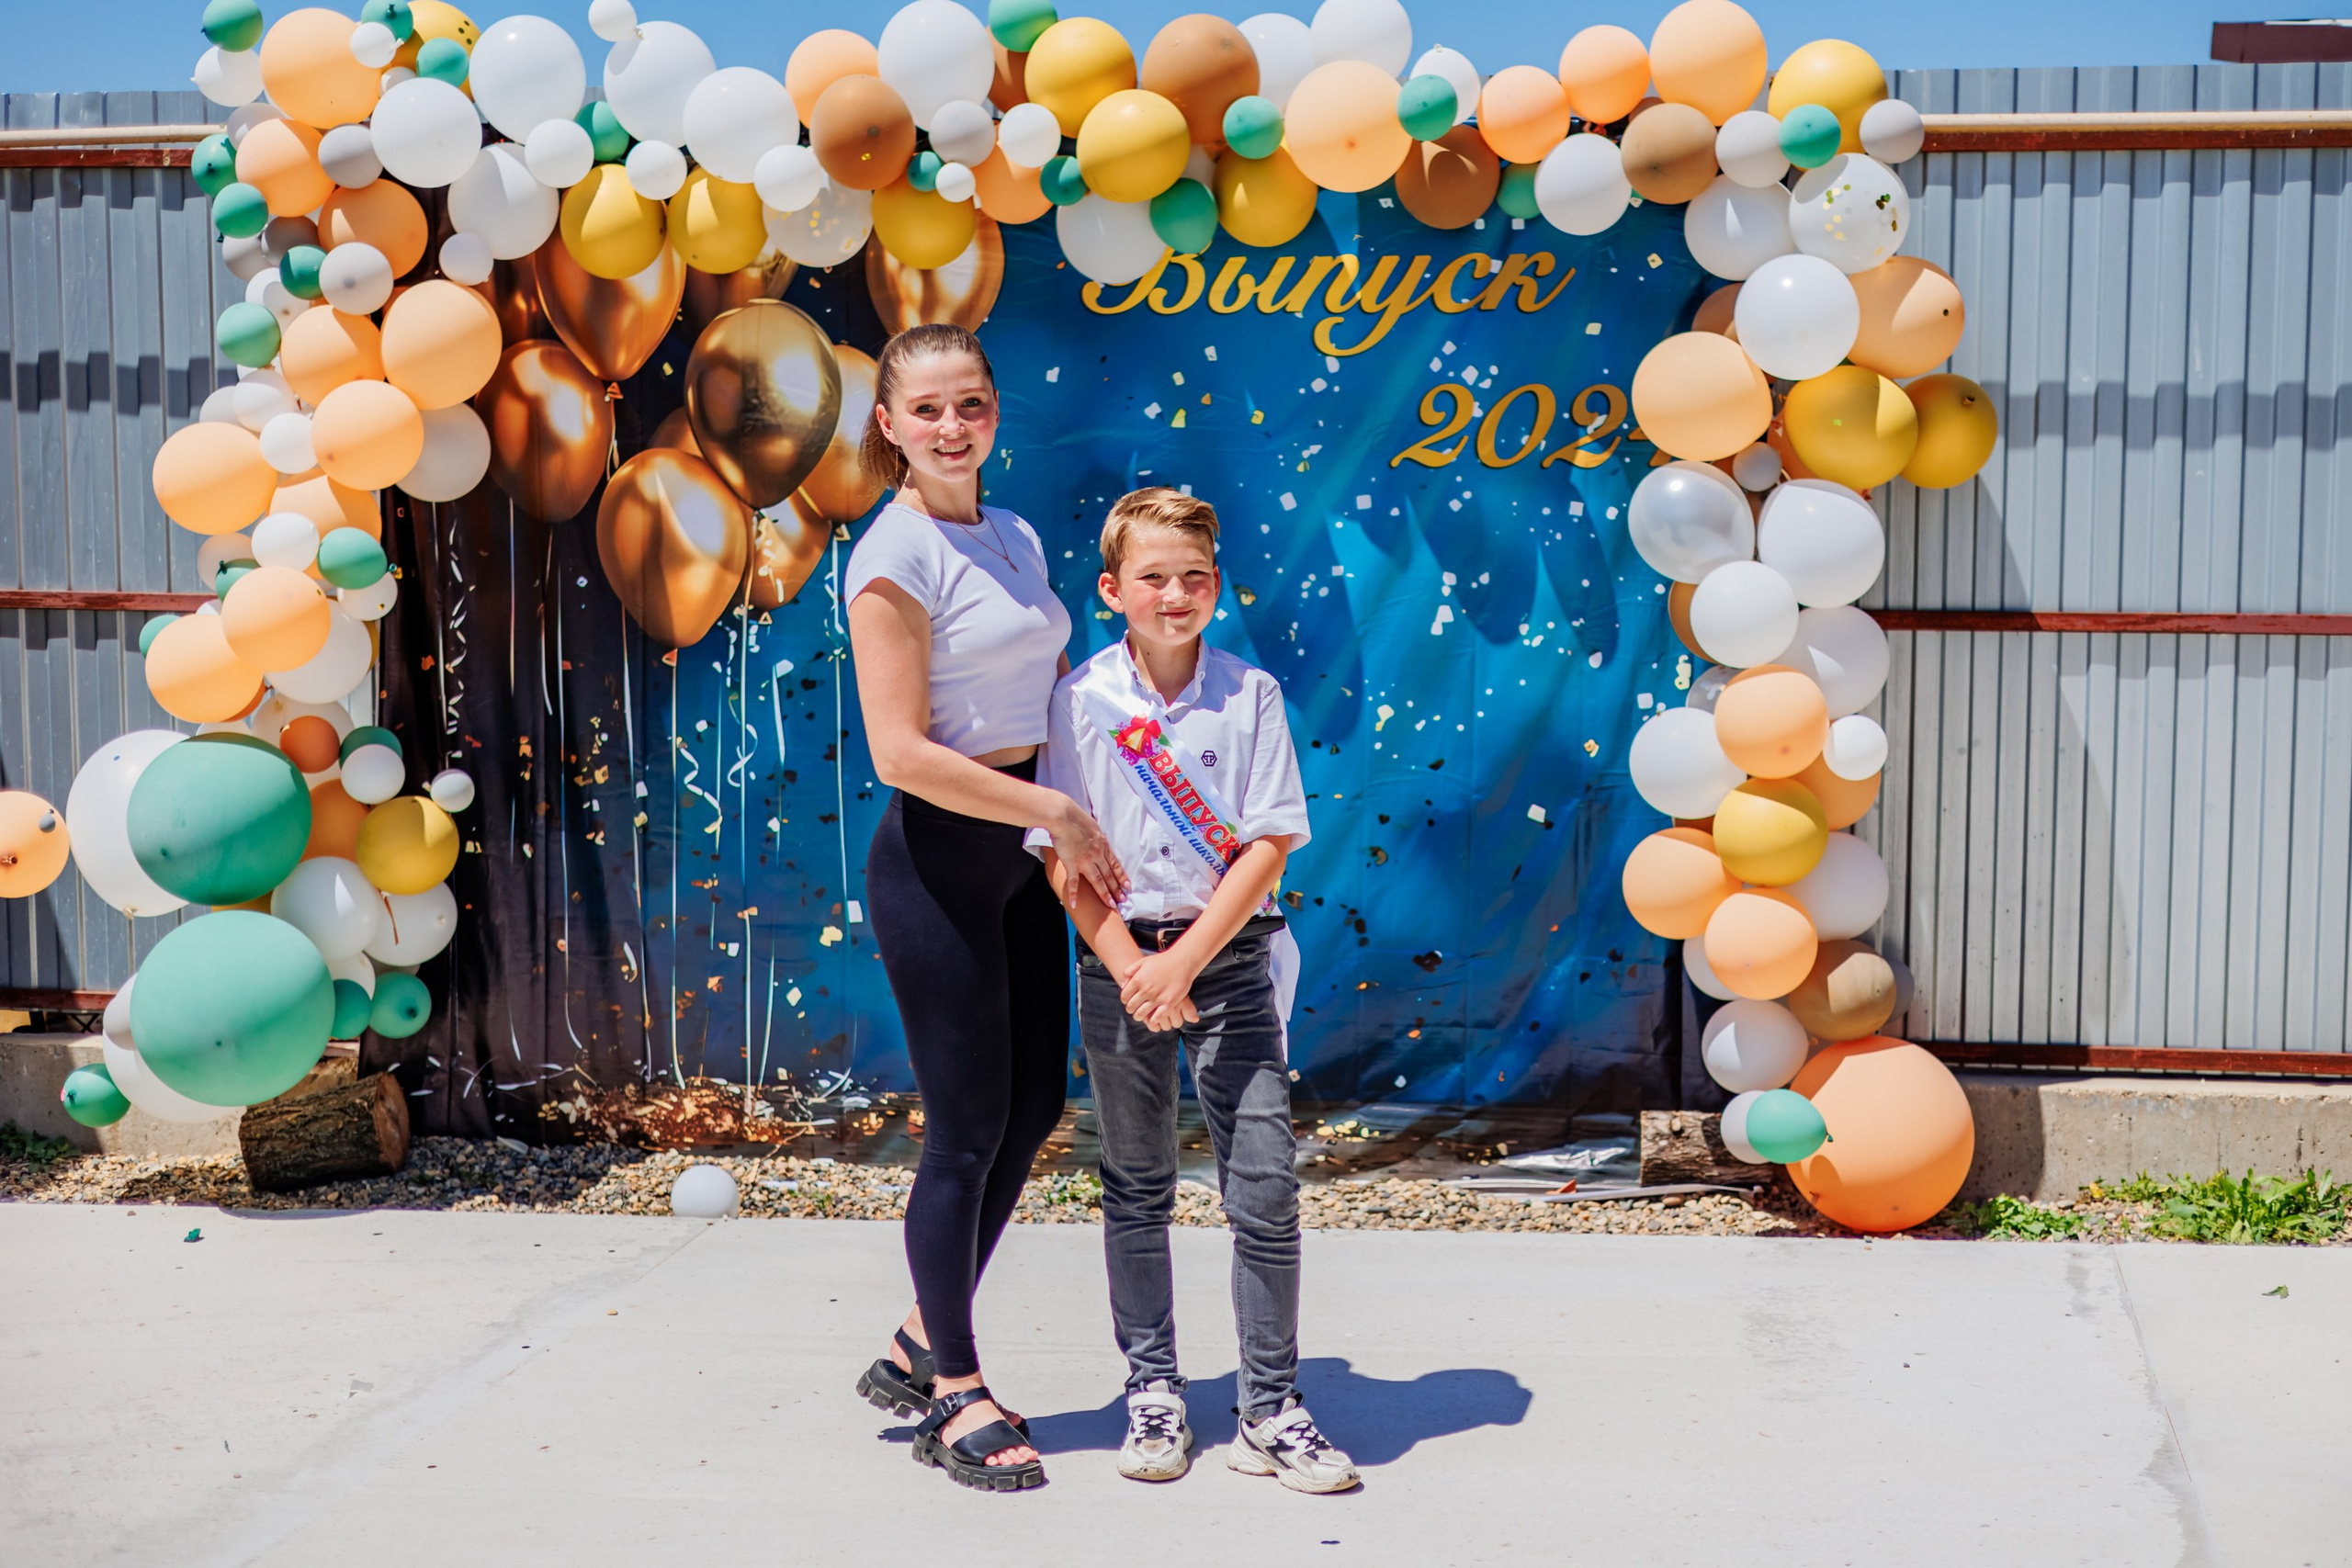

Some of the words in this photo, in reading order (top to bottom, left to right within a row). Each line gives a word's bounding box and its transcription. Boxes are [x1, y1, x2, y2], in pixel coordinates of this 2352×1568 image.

[1081, 240, 1576, 355] Выпуск
[1390, 383, 1676, 468] 202
[1135, 764, 1198, 838] начальной
[1148, 750, 1242, 864] ВЫПУСК
